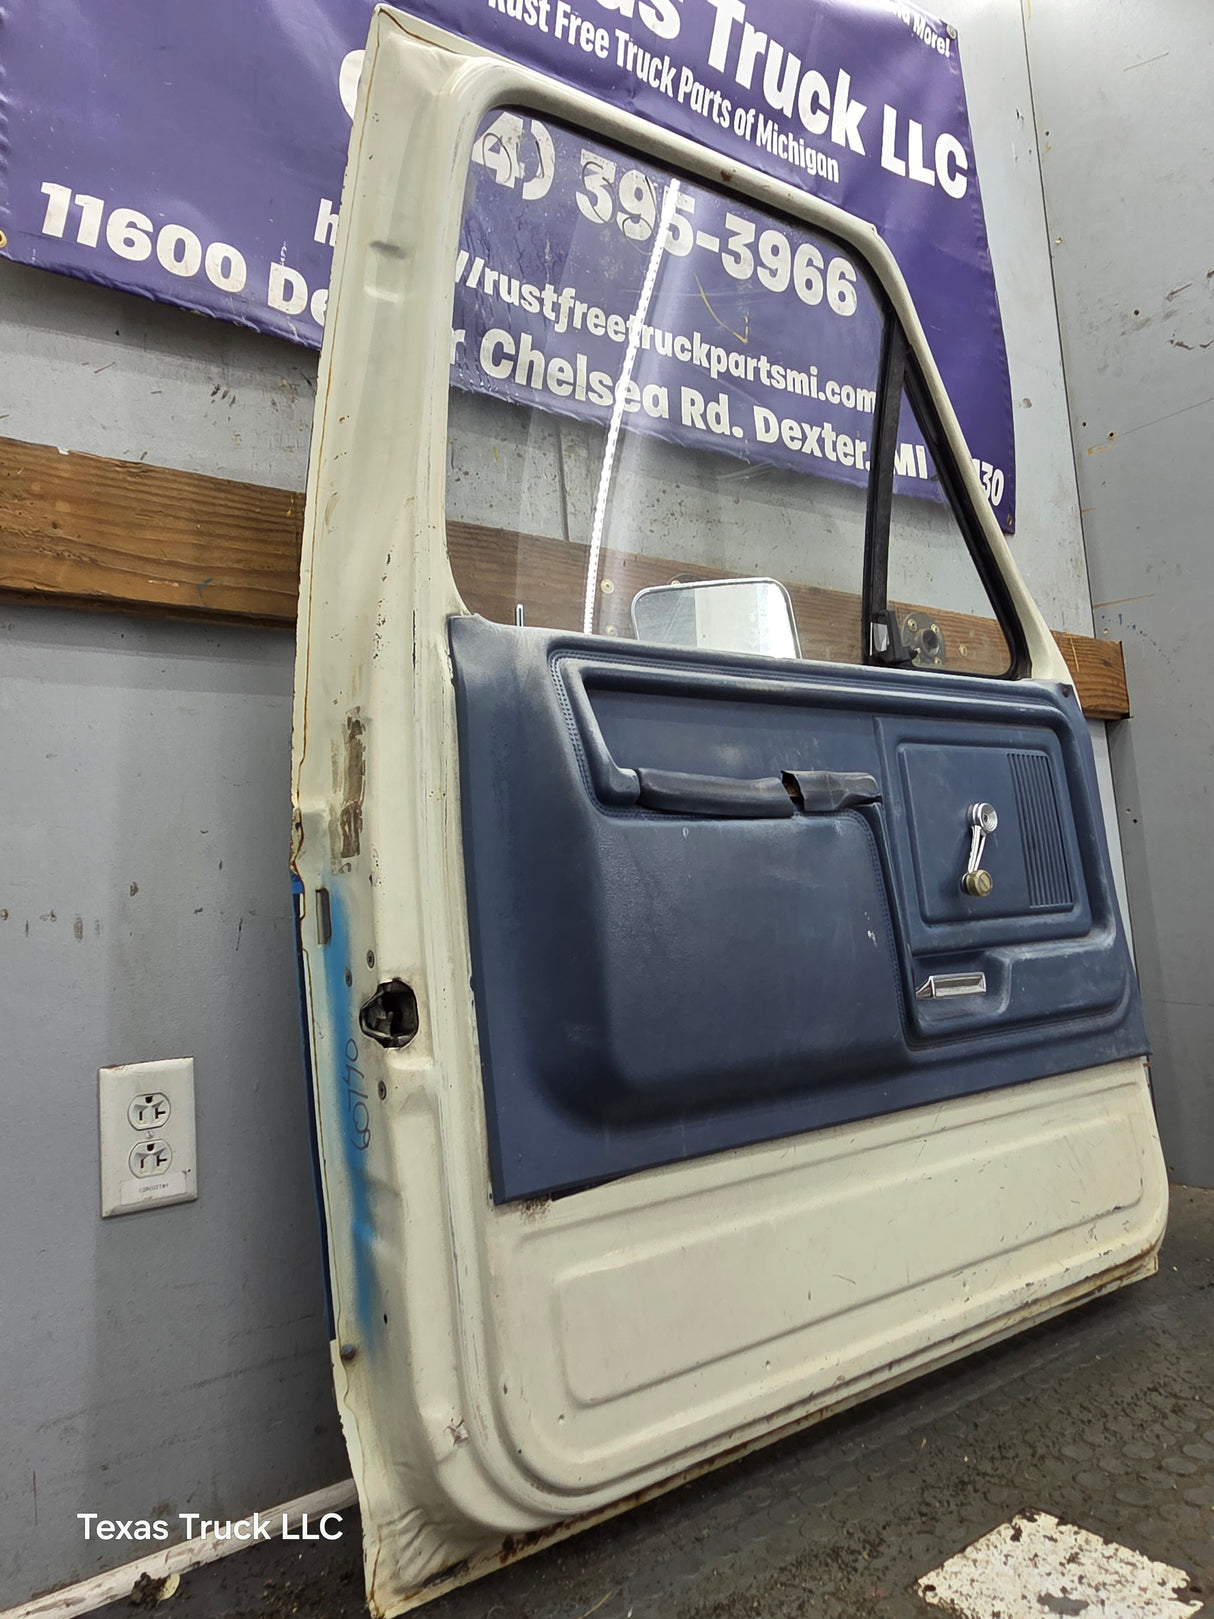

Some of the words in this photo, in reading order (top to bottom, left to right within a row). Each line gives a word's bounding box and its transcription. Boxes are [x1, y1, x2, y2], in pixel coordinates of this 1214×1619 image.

[554, 2, 610, 59] Free
[615, 28, 677, 98] Truck
[677, 65, 731, 126] Parts
[733, 106, 756, 139] of
[756, 112, 839, 184] Michigan
[703, 0, 867, 156] Truck
[880, 104, 968, 199] LLC
[575, 148, 858, 317] 395-3966
[41, 181, 247, 293] 11600
[479, 328, 669, 419] Chelsea
[681, 388, 744, 439] Rd.
[893, 443, 928, 480] MI
